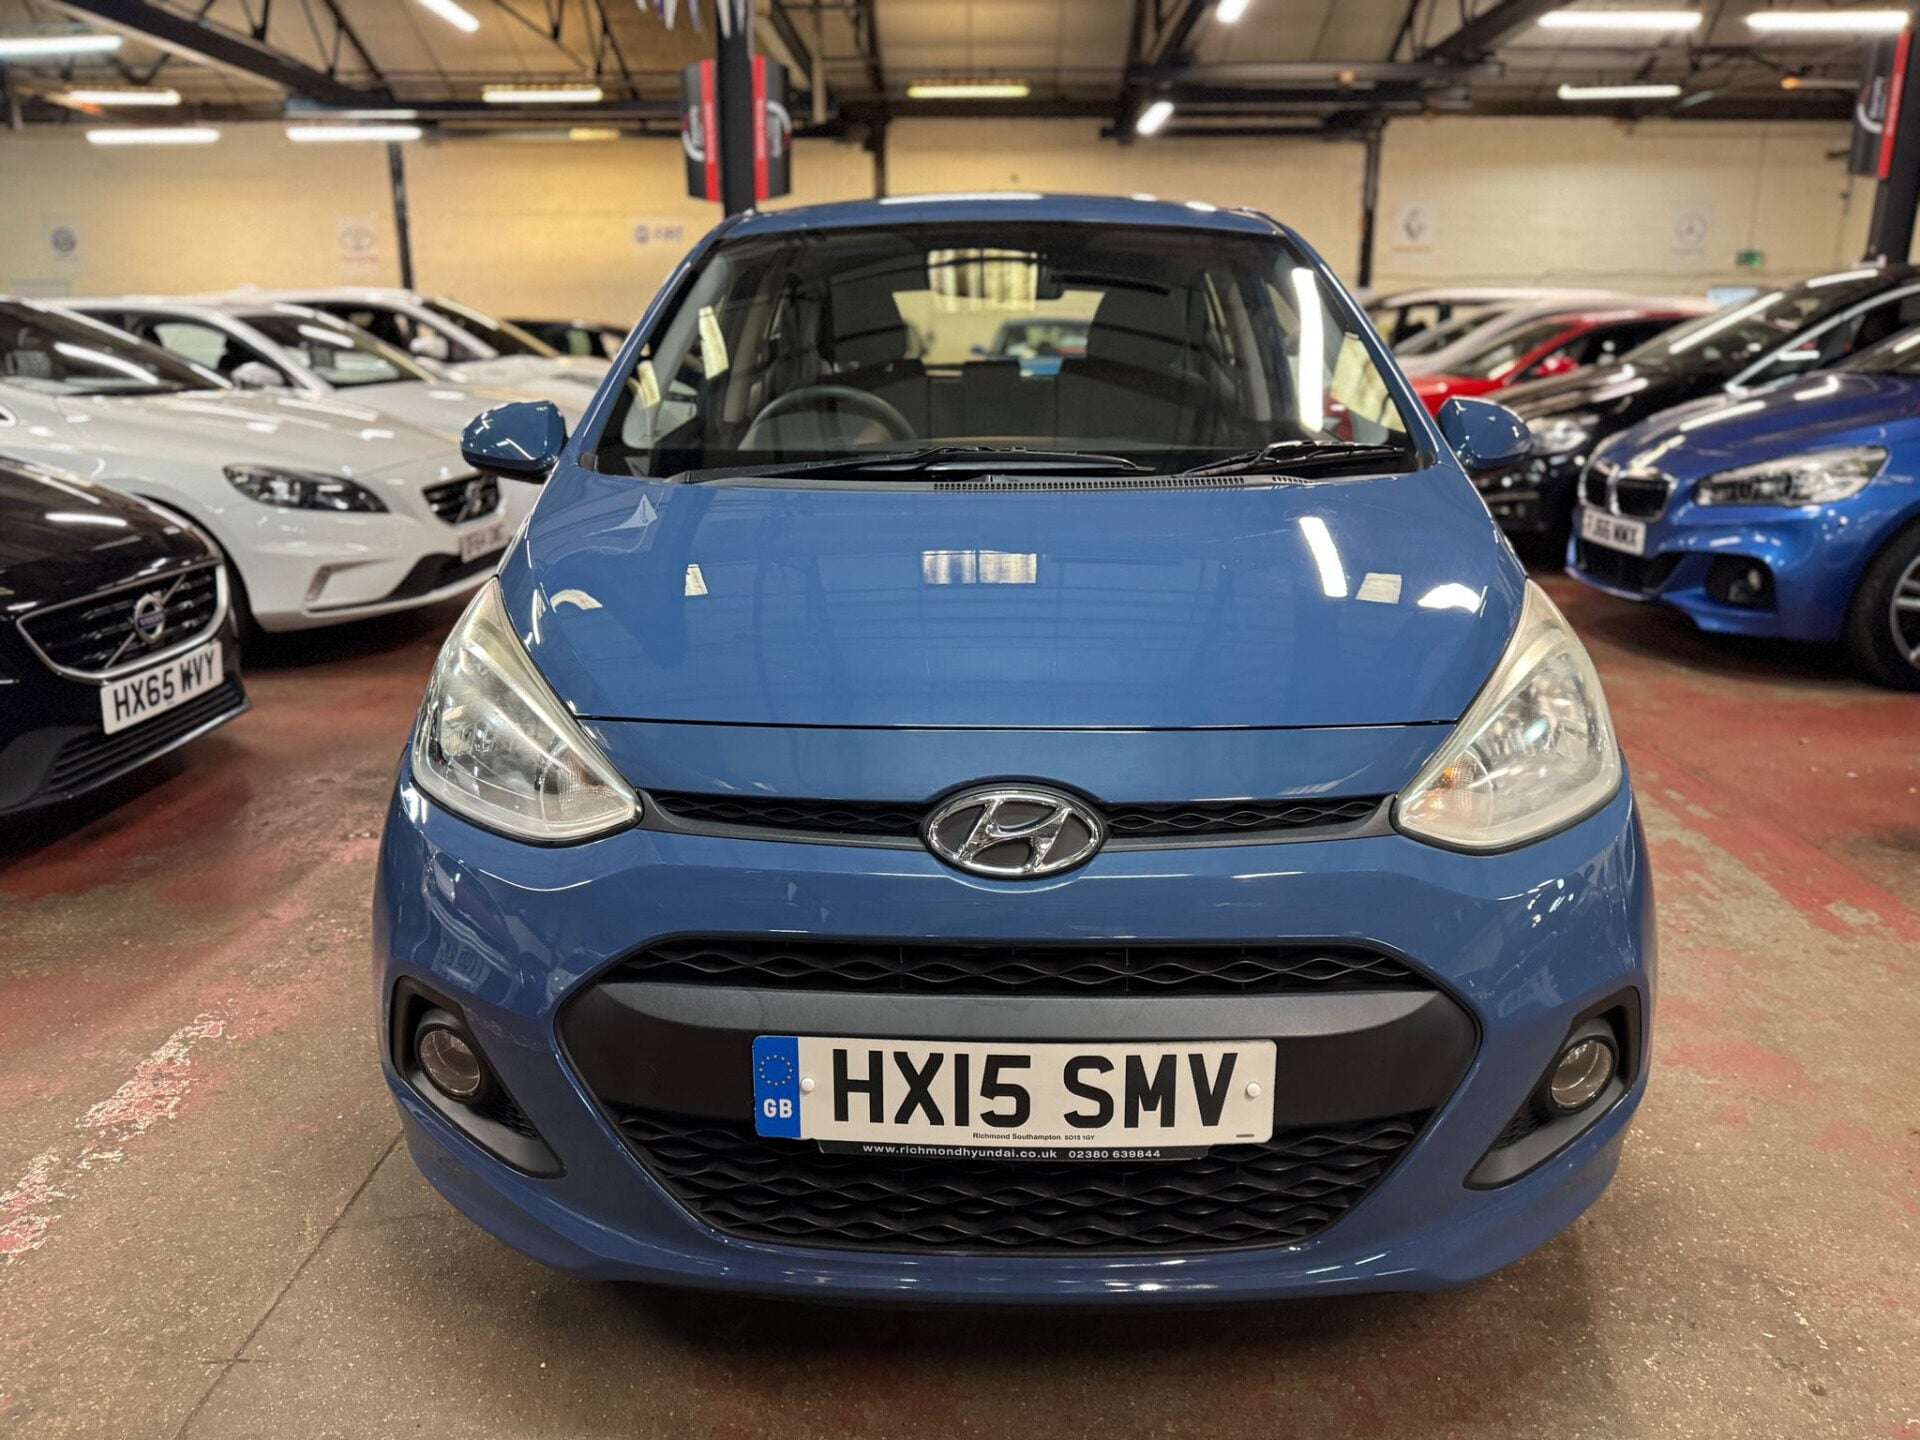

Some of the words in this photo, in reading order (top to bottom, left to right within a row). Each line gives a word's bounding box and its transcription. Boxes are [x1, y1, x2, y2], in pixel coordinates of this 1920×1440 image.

[113, 668, 175, 722] HX65
[180, 651, 214, 693] WVY
[832, 1048, 1032, 1129] HX15
[1063, 1052, 1239, 1129] SMV
[763, 1099, 793, 1119] GB
[973, 1132, 1010, 1140] Richmond
[1012, 1133, 1061, 1141] Southampton
[862, 1145, 1057, 1158] www.richmondhyundai.co.uk
[1068, 1150, 1109, 1158] 02380
[1112, 1150, 1161, 1158] 639844
